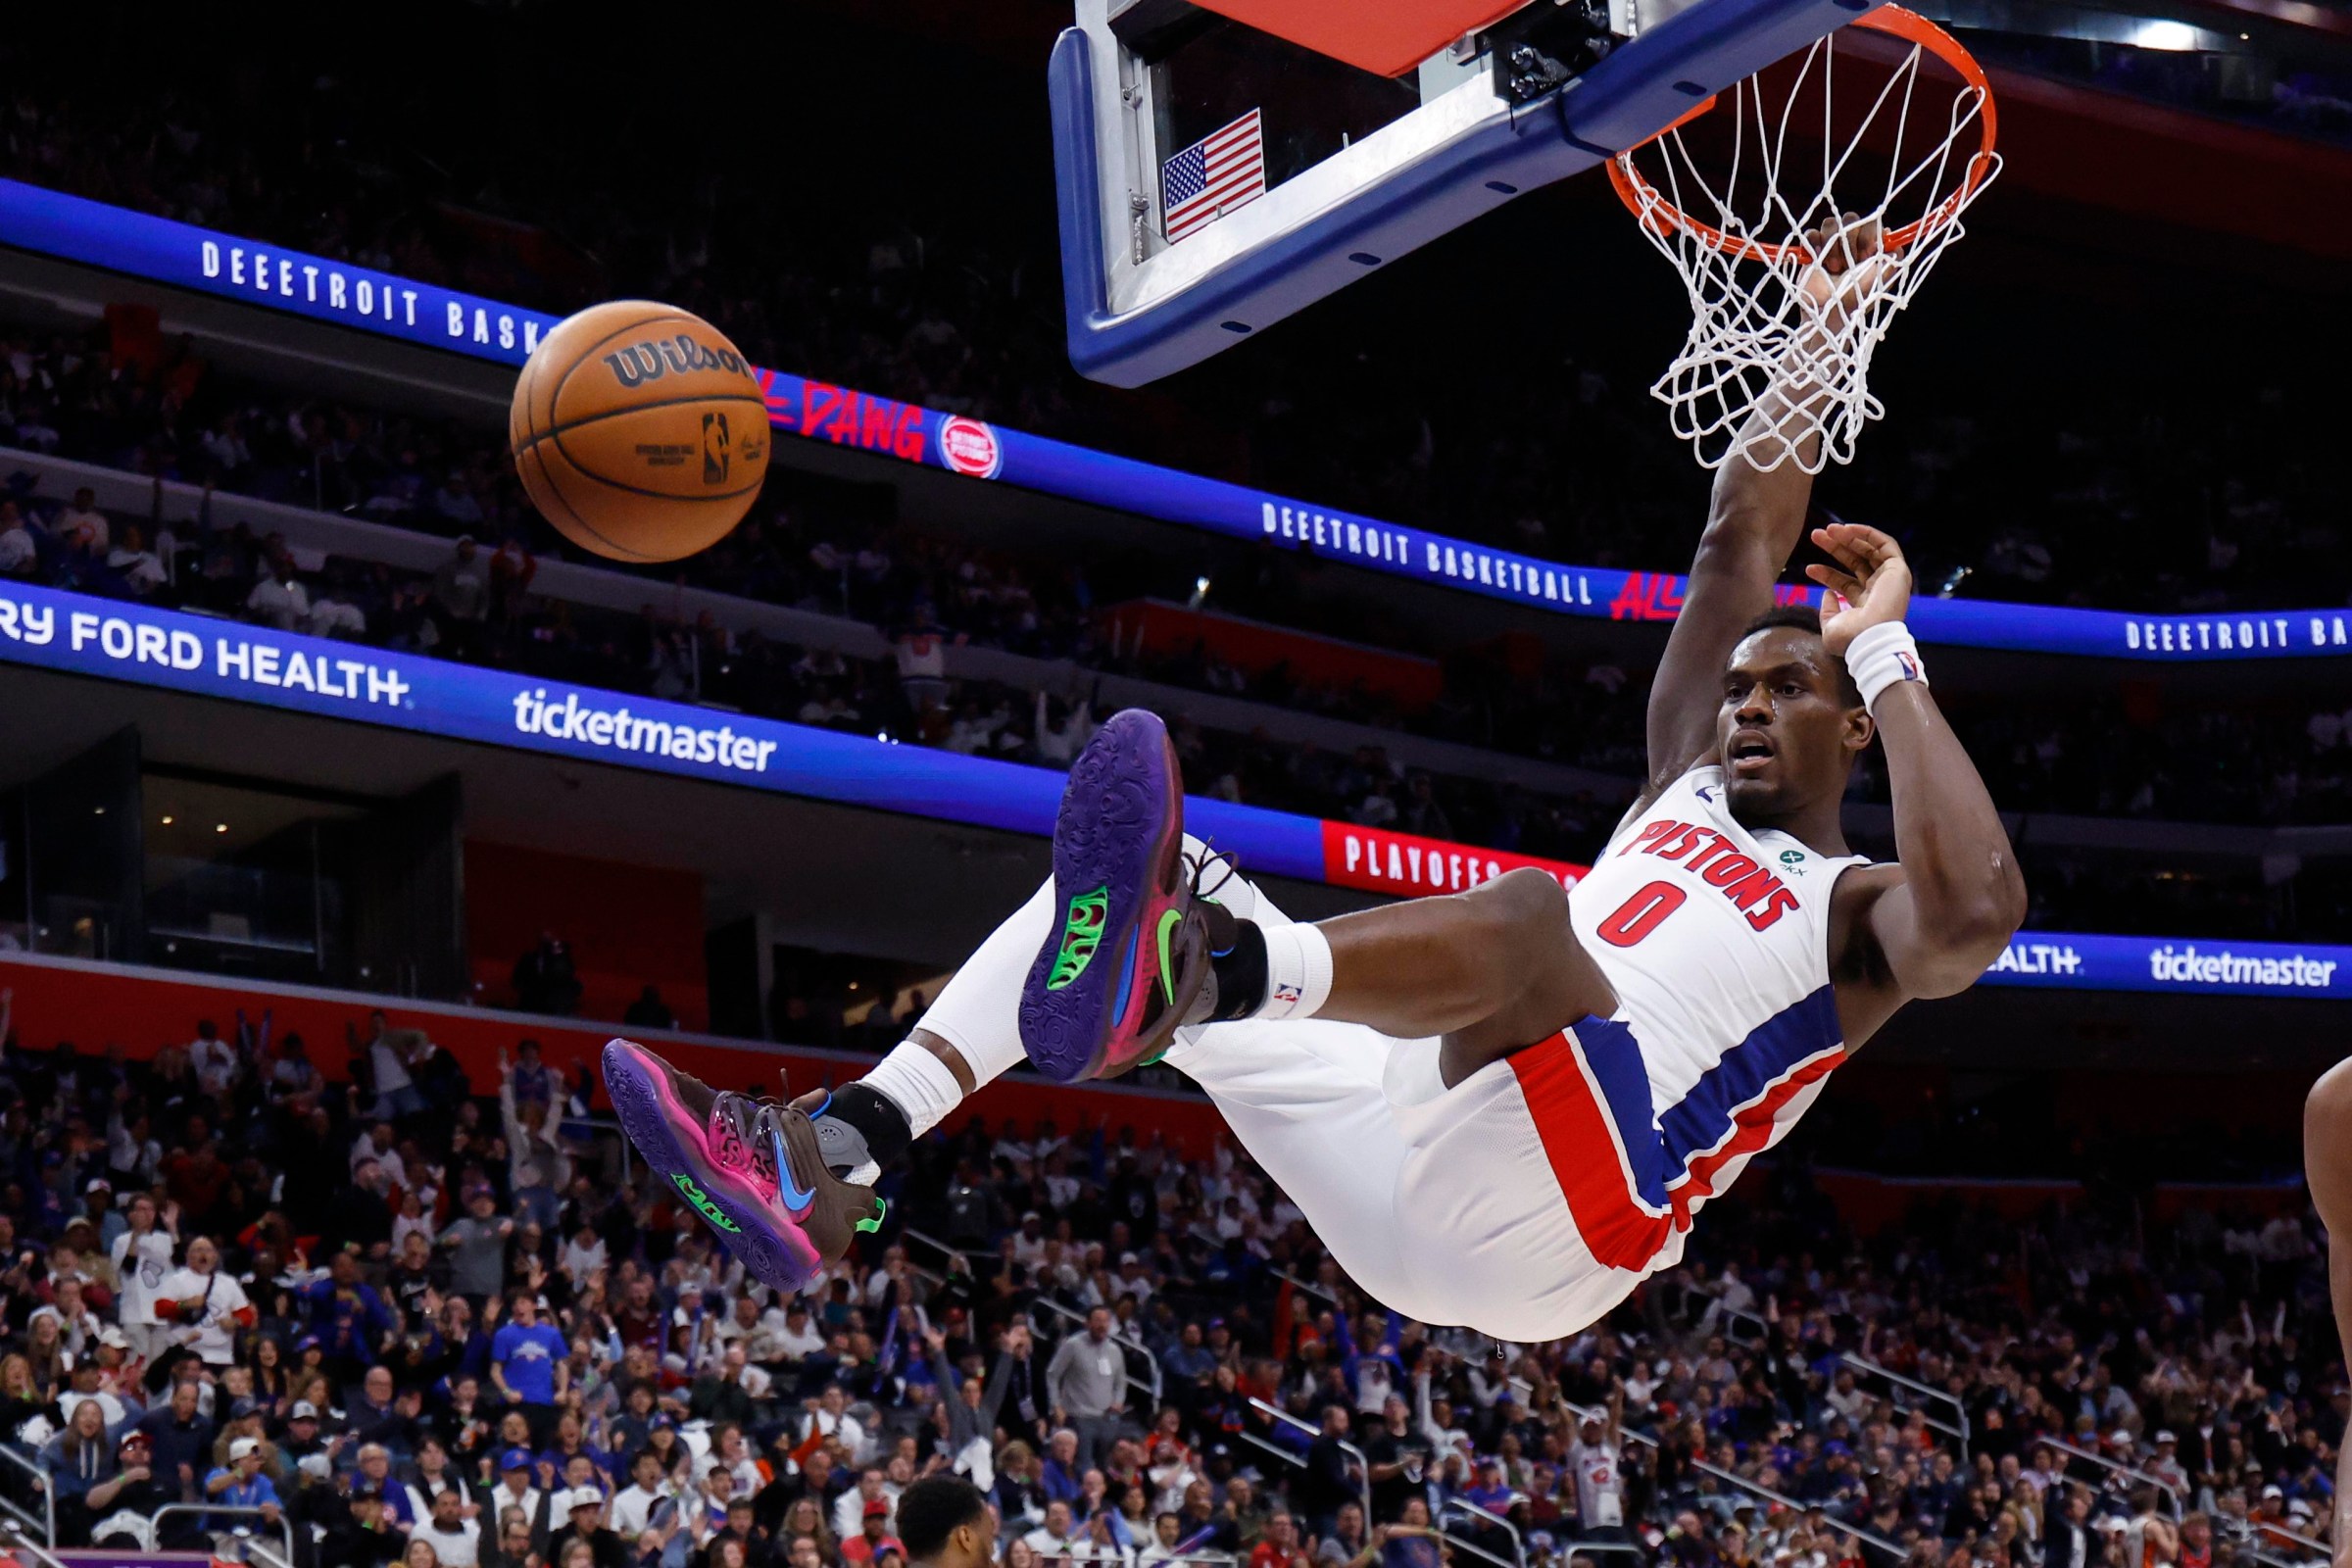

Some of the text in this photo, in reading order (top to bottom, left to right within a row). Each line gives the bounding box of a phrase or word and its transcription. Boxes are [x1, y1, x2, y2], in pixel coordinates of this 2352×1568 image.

[202, 240, 542, 356] DEEETROIT BASK
[1262, 502, 1592, 606] DEEETROIT BASKETBALL
[1610, 571, 1685, 620] ALL
[0, 599, 55, 645] RY
[71, 612, 204, 670] FORD
[2126, 616, 2347, 651] DEEETROIT BA
[513, 688, 777, 772] ticketmaster
[1616, 819, 1800, 932] PISTONS
[1596, 880, 1687, 948] 0
[2150, 945, 2337, 987] ticketmaster
